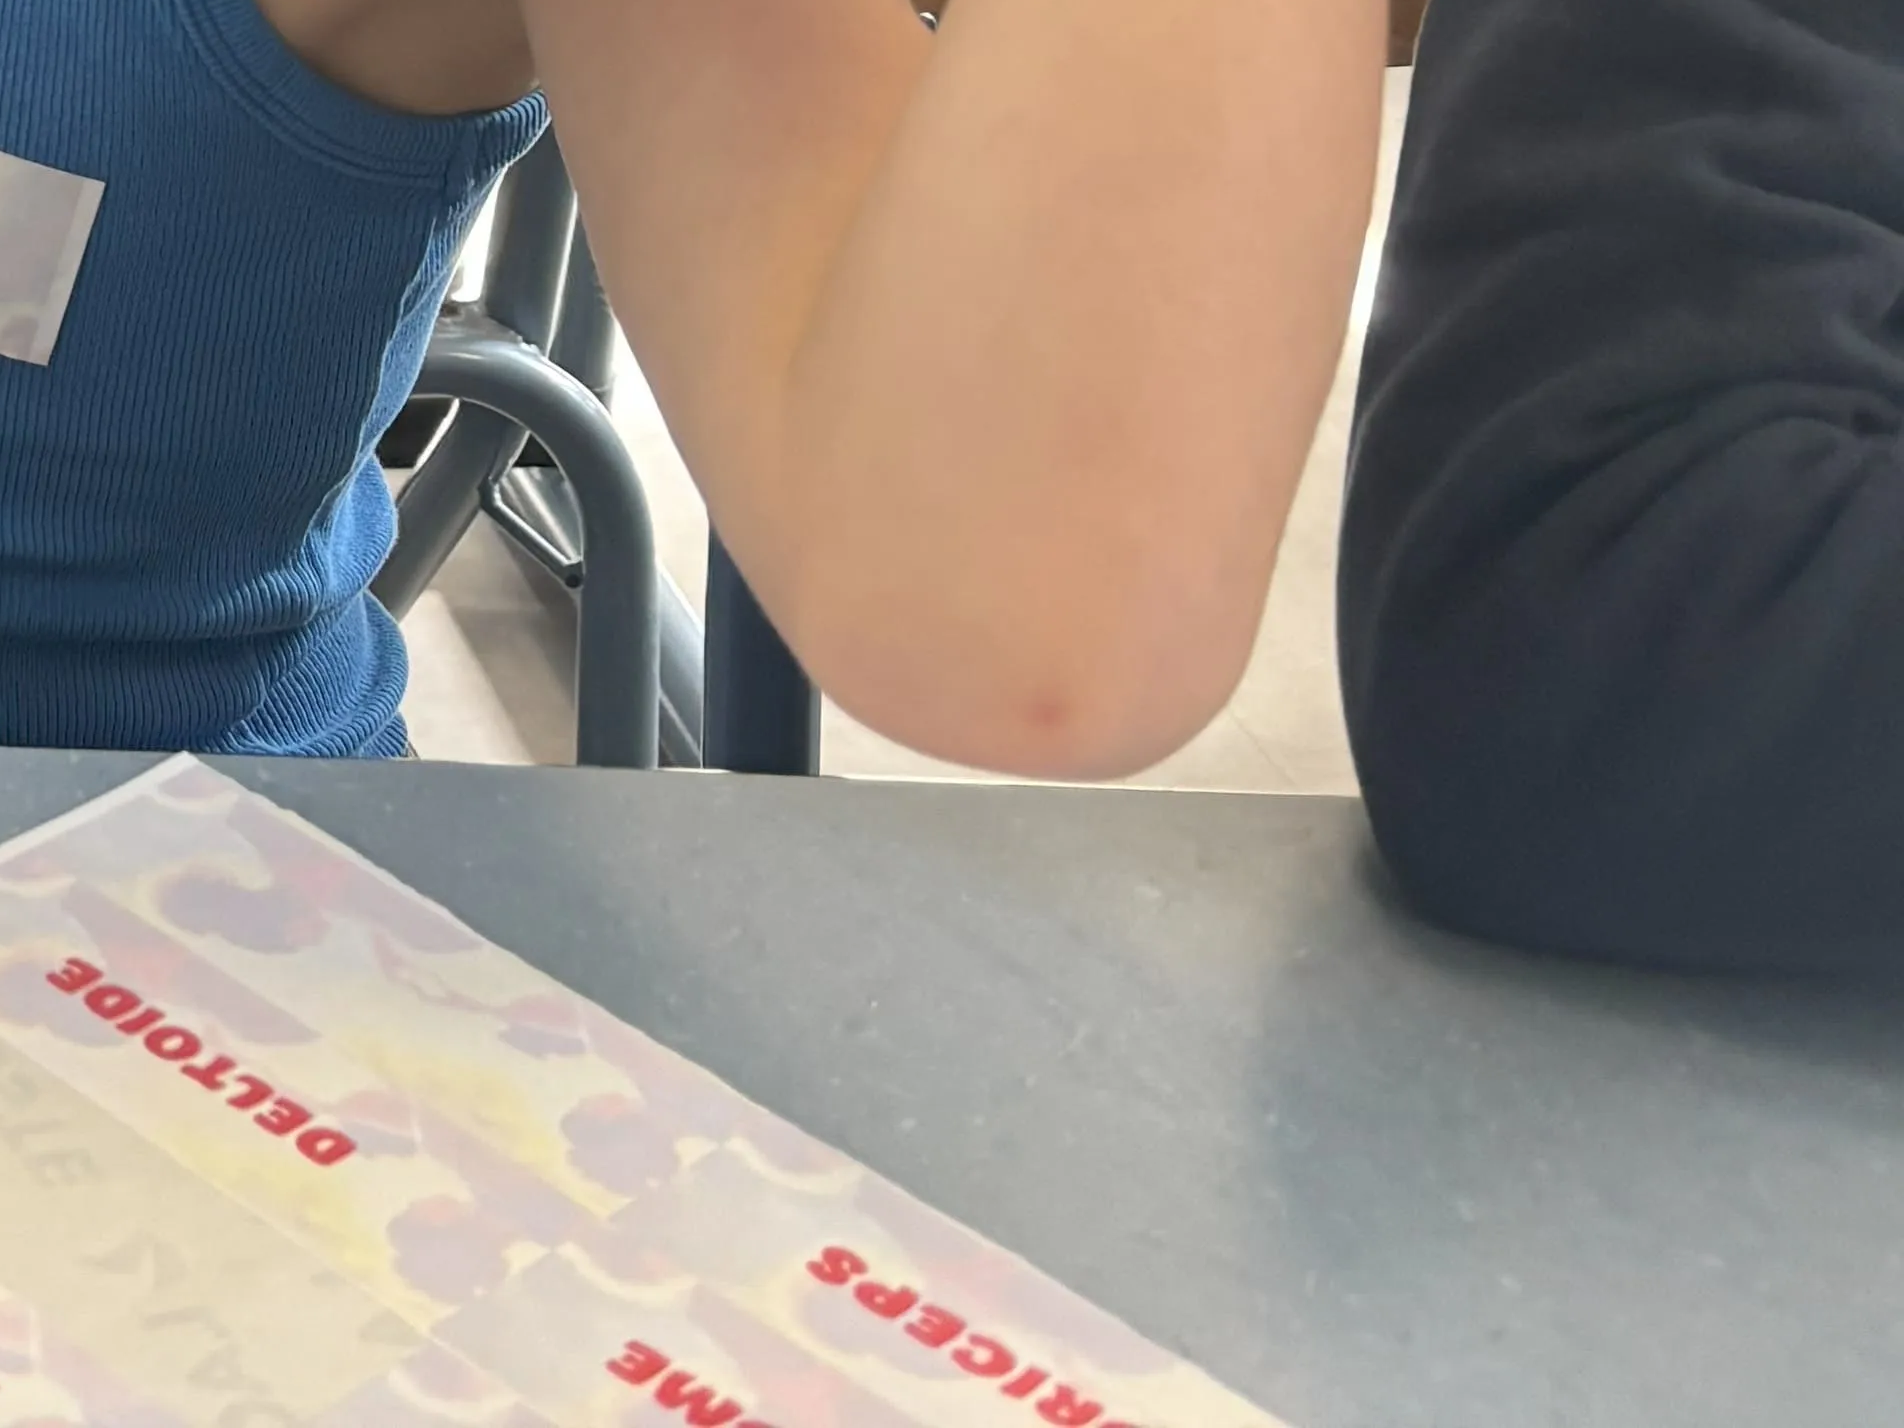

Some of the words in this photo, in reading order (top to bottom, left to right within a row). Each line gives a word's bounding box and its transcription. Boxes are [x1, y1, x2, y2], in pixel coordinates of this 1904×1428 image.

[46, 957, 358, 1168] DELTOIDE
[605, 1339, 784, 1428] ME
[805, 1245, 1132, 1428] RICEPS
